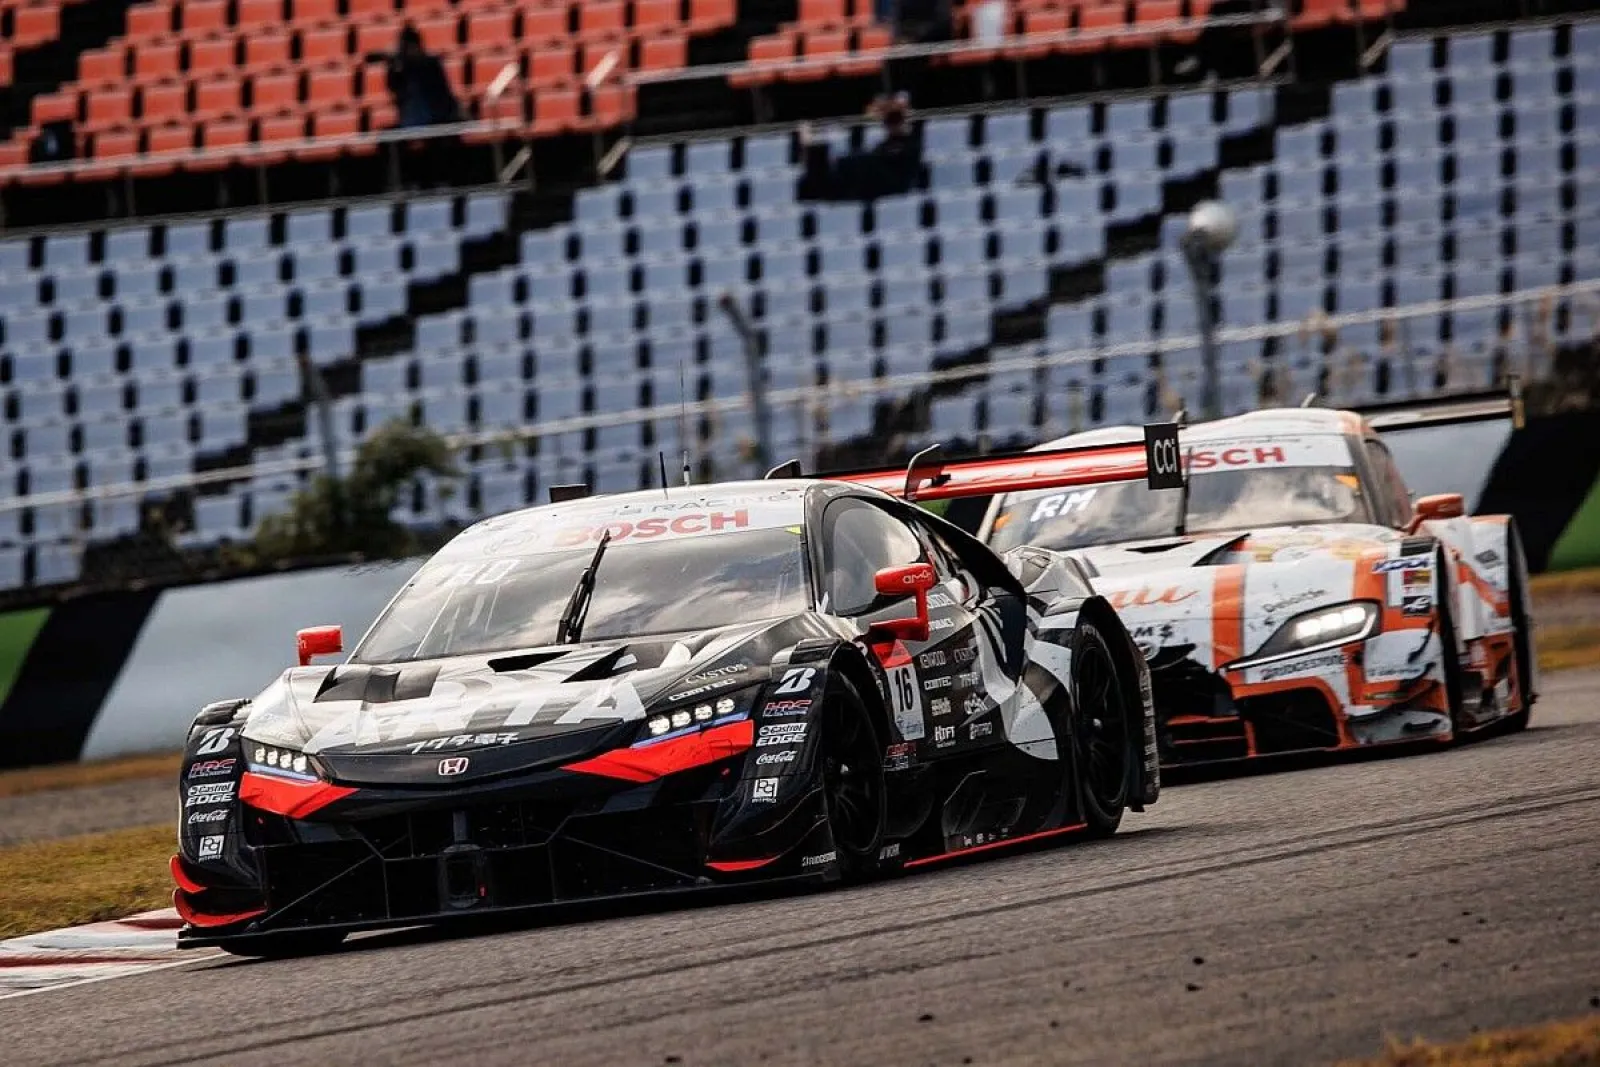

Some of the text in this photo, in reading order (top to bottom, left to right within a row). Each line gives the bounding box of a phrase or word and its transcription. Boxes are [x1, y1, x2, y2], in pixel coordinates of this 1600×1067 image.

[1182, 447, 1285, 468] SCH
[1030, 489, 1097, 522] RM
[553, 509, 749, 548] BOSCH
[895, 667, 914, 712] 16
[770, 723, 802, 734] Castrol
[756, 733, 807, 747] EDGE
[200, 783, 233, 794] Castrol
[185, 792, 235, 807] EDGE
